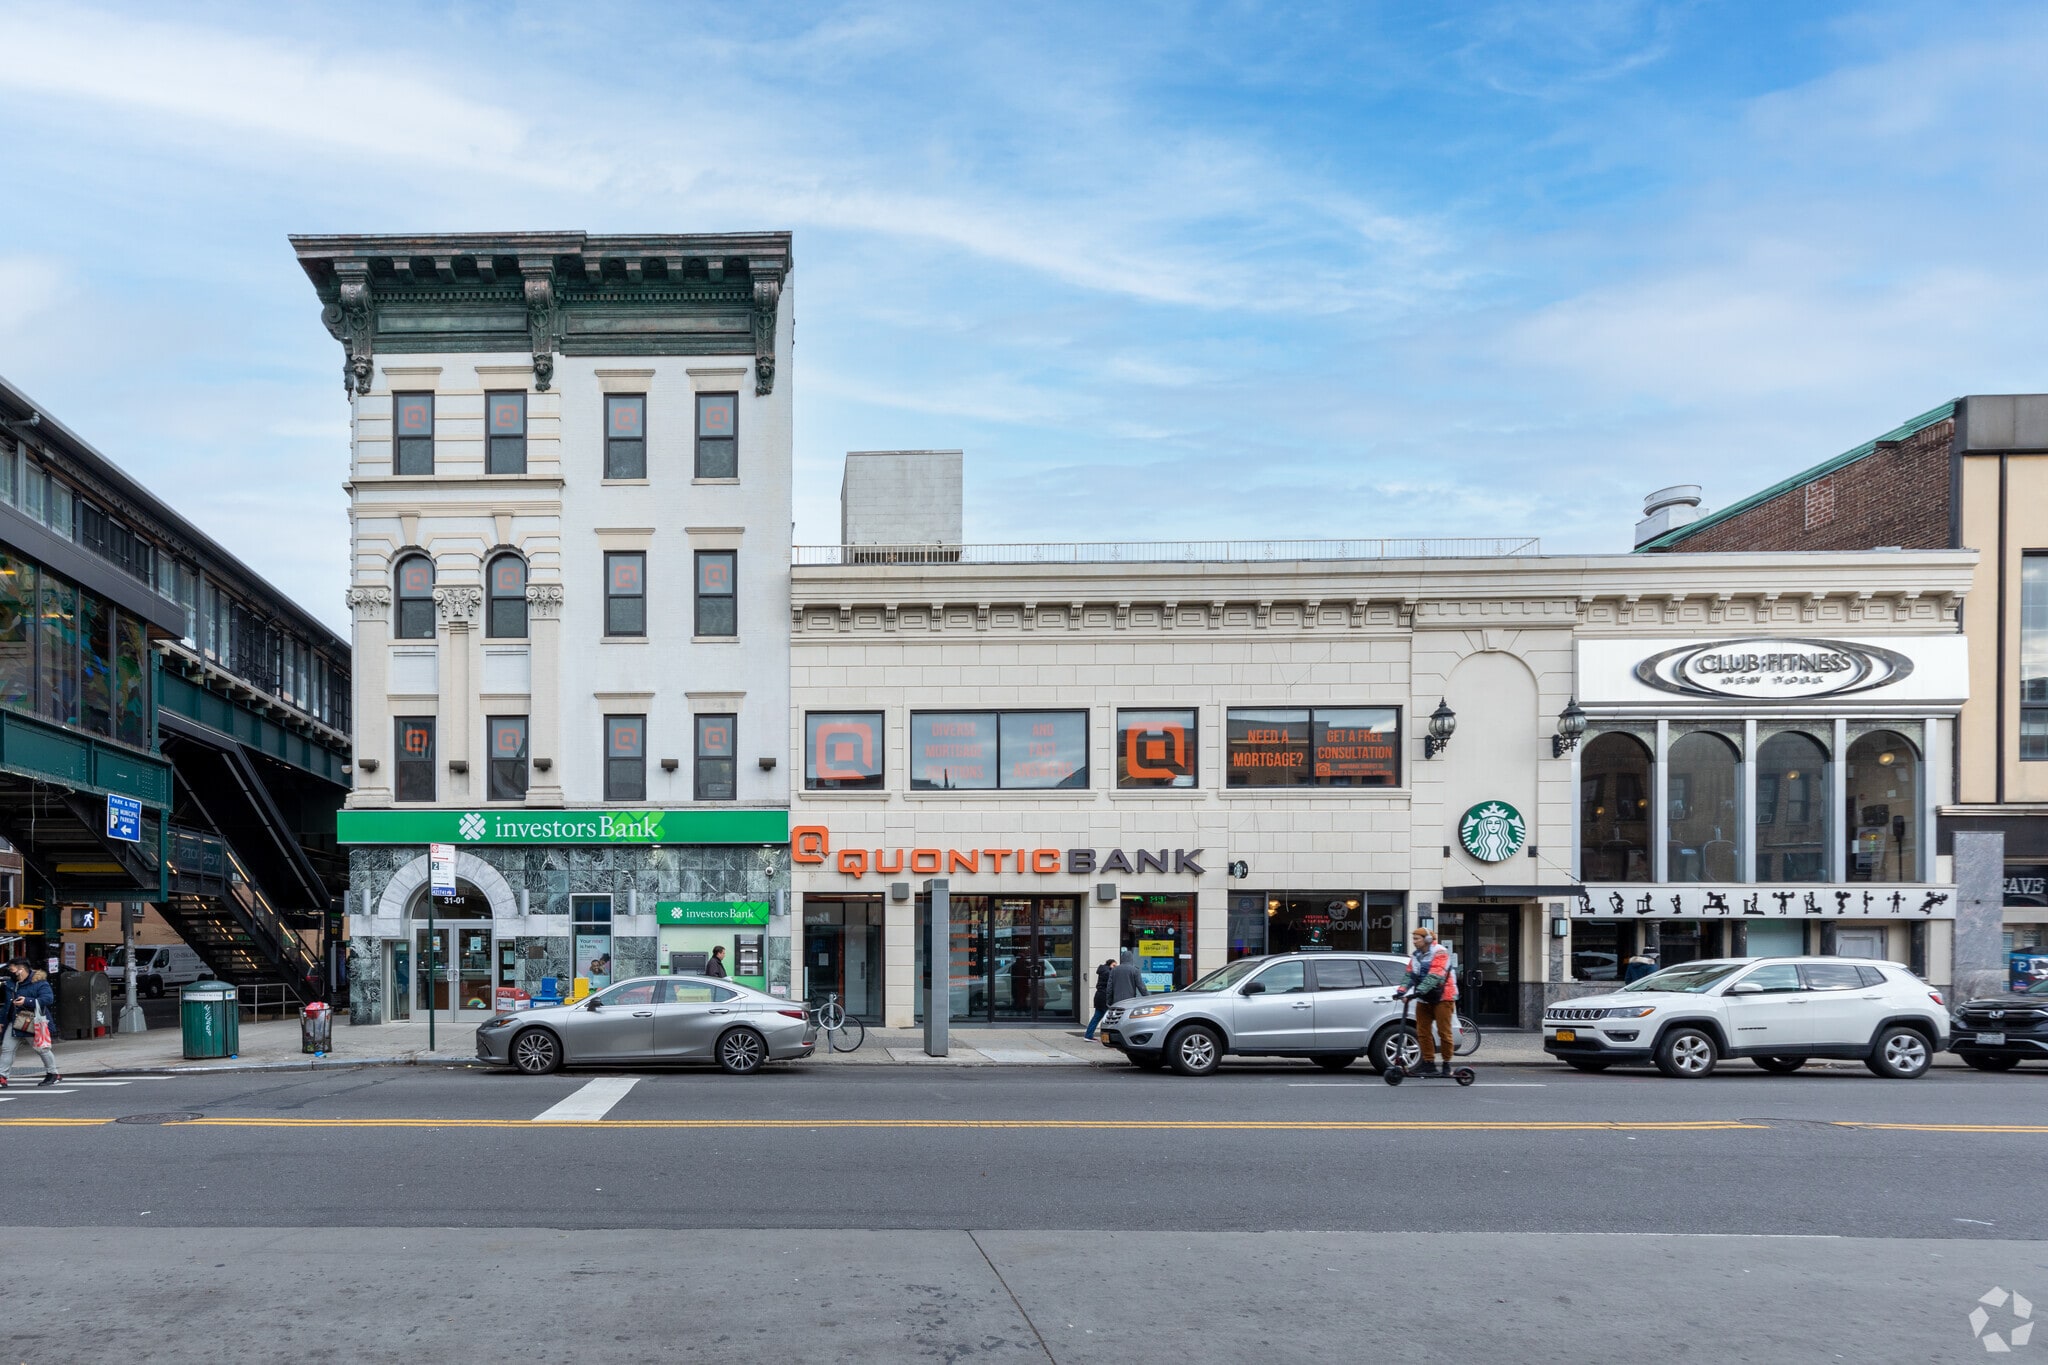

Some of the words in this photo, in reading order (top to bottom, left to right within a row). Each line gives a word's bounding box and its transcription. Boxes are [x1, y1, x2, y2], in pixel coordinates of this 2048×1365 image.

[1698, 653, 1760, 673] CLUB
[1767, 652, 1852, 673] FITNESS
[931, 722, 977, 737] DIVERSE
[1032, 722, 1055, 737] AND
[1247, 729, 1278, 744] NEED
[1280, 729, 1289, 744] A
[1327, 729, 1344, 743] GET
[1348, 729, 1355, 743] A
[1357, 731, 1383, 743] FREE
[925, 744, 984, 758] MORTGAGE
[1028, 742, 1057, 757] FAST
[1317, 746, 1393, 759] CONSULTATION
[1233, 752, 1304, 767] MORTGAGE?
[1013, 762, 1074, 778] ANSWERS
[111, 797, 123, 805] PARK
[2002, 877, 2046, 894] AVE
[444, 896, 465, 905] 31-01
